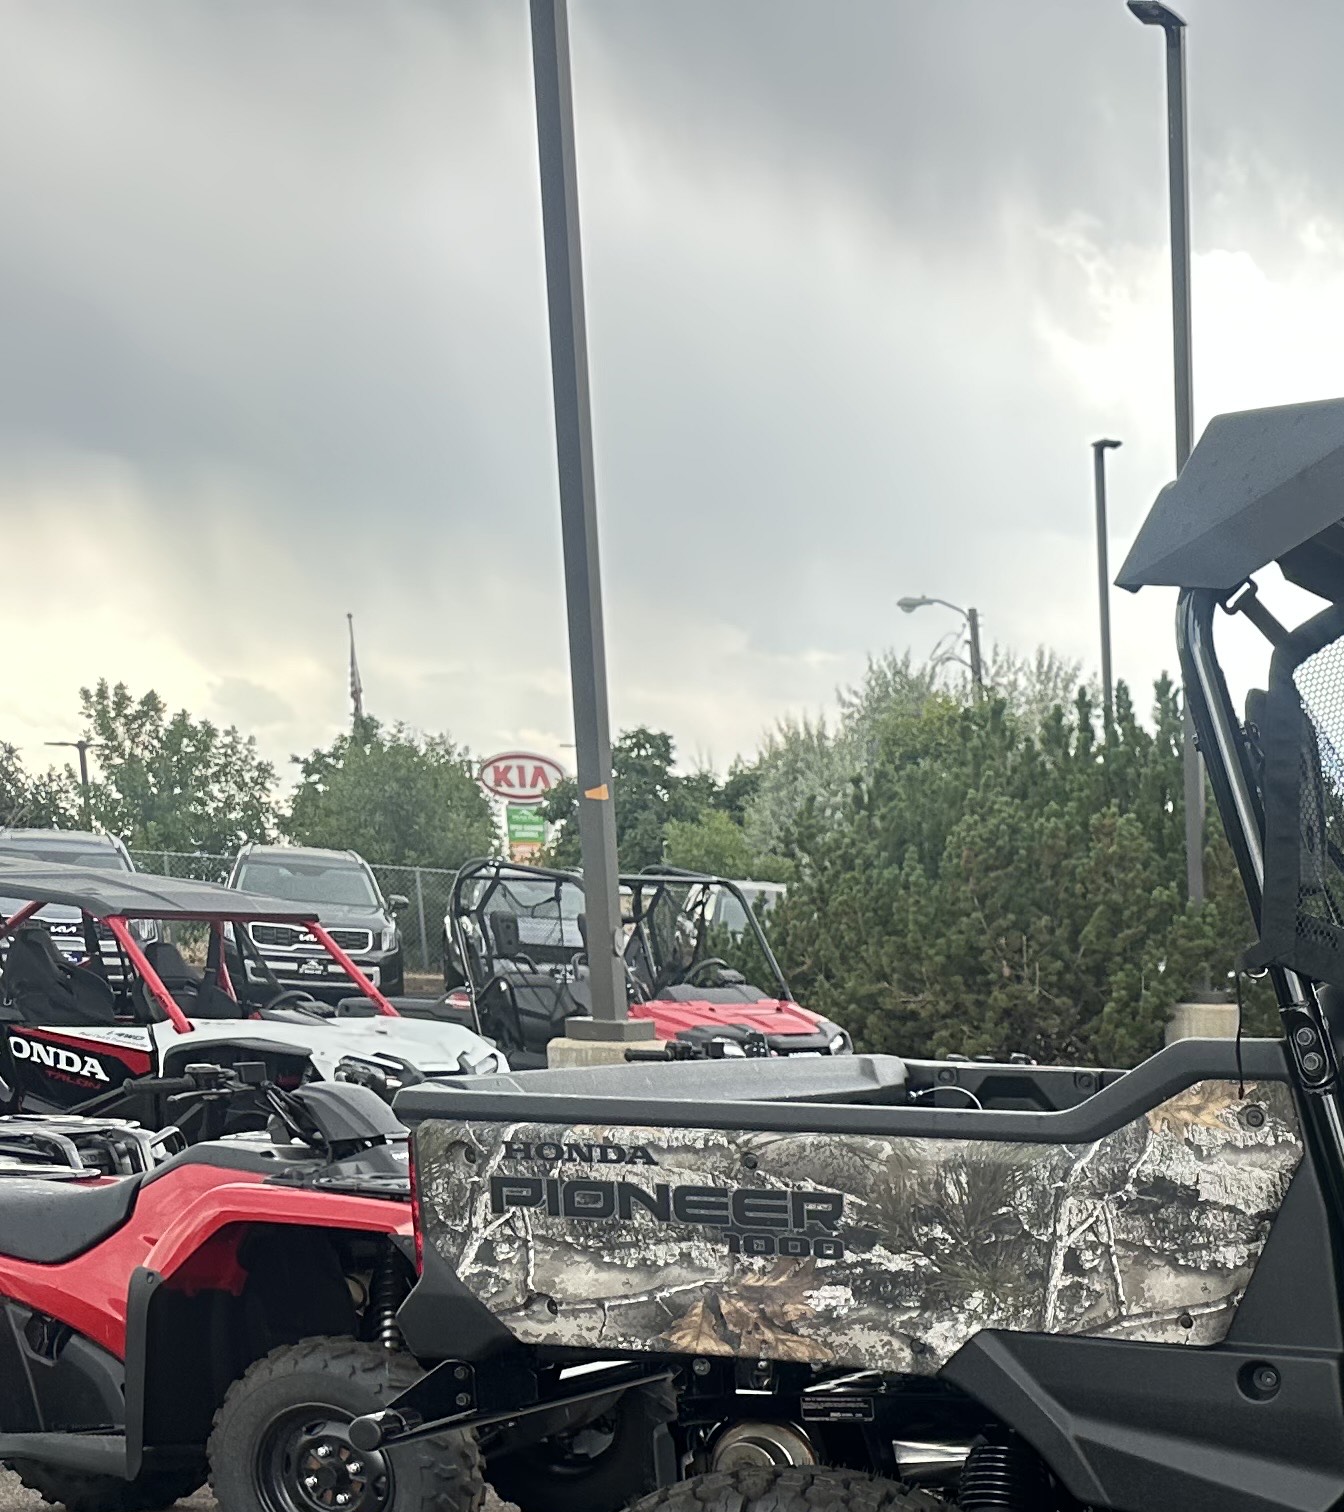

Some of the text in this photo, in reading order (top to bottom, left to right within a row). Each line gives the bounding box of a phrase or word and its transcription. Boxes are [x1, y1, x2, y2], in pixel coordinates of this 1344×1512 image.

[493, 765, 551, 788] KIA
[8, 1036, 110, 1082] ONDA
[502, 1140, 659, 1166] HONDA
[490, 1176, 845, 1232] PIONEER
[722, 1232, 845, 1260] 1000
